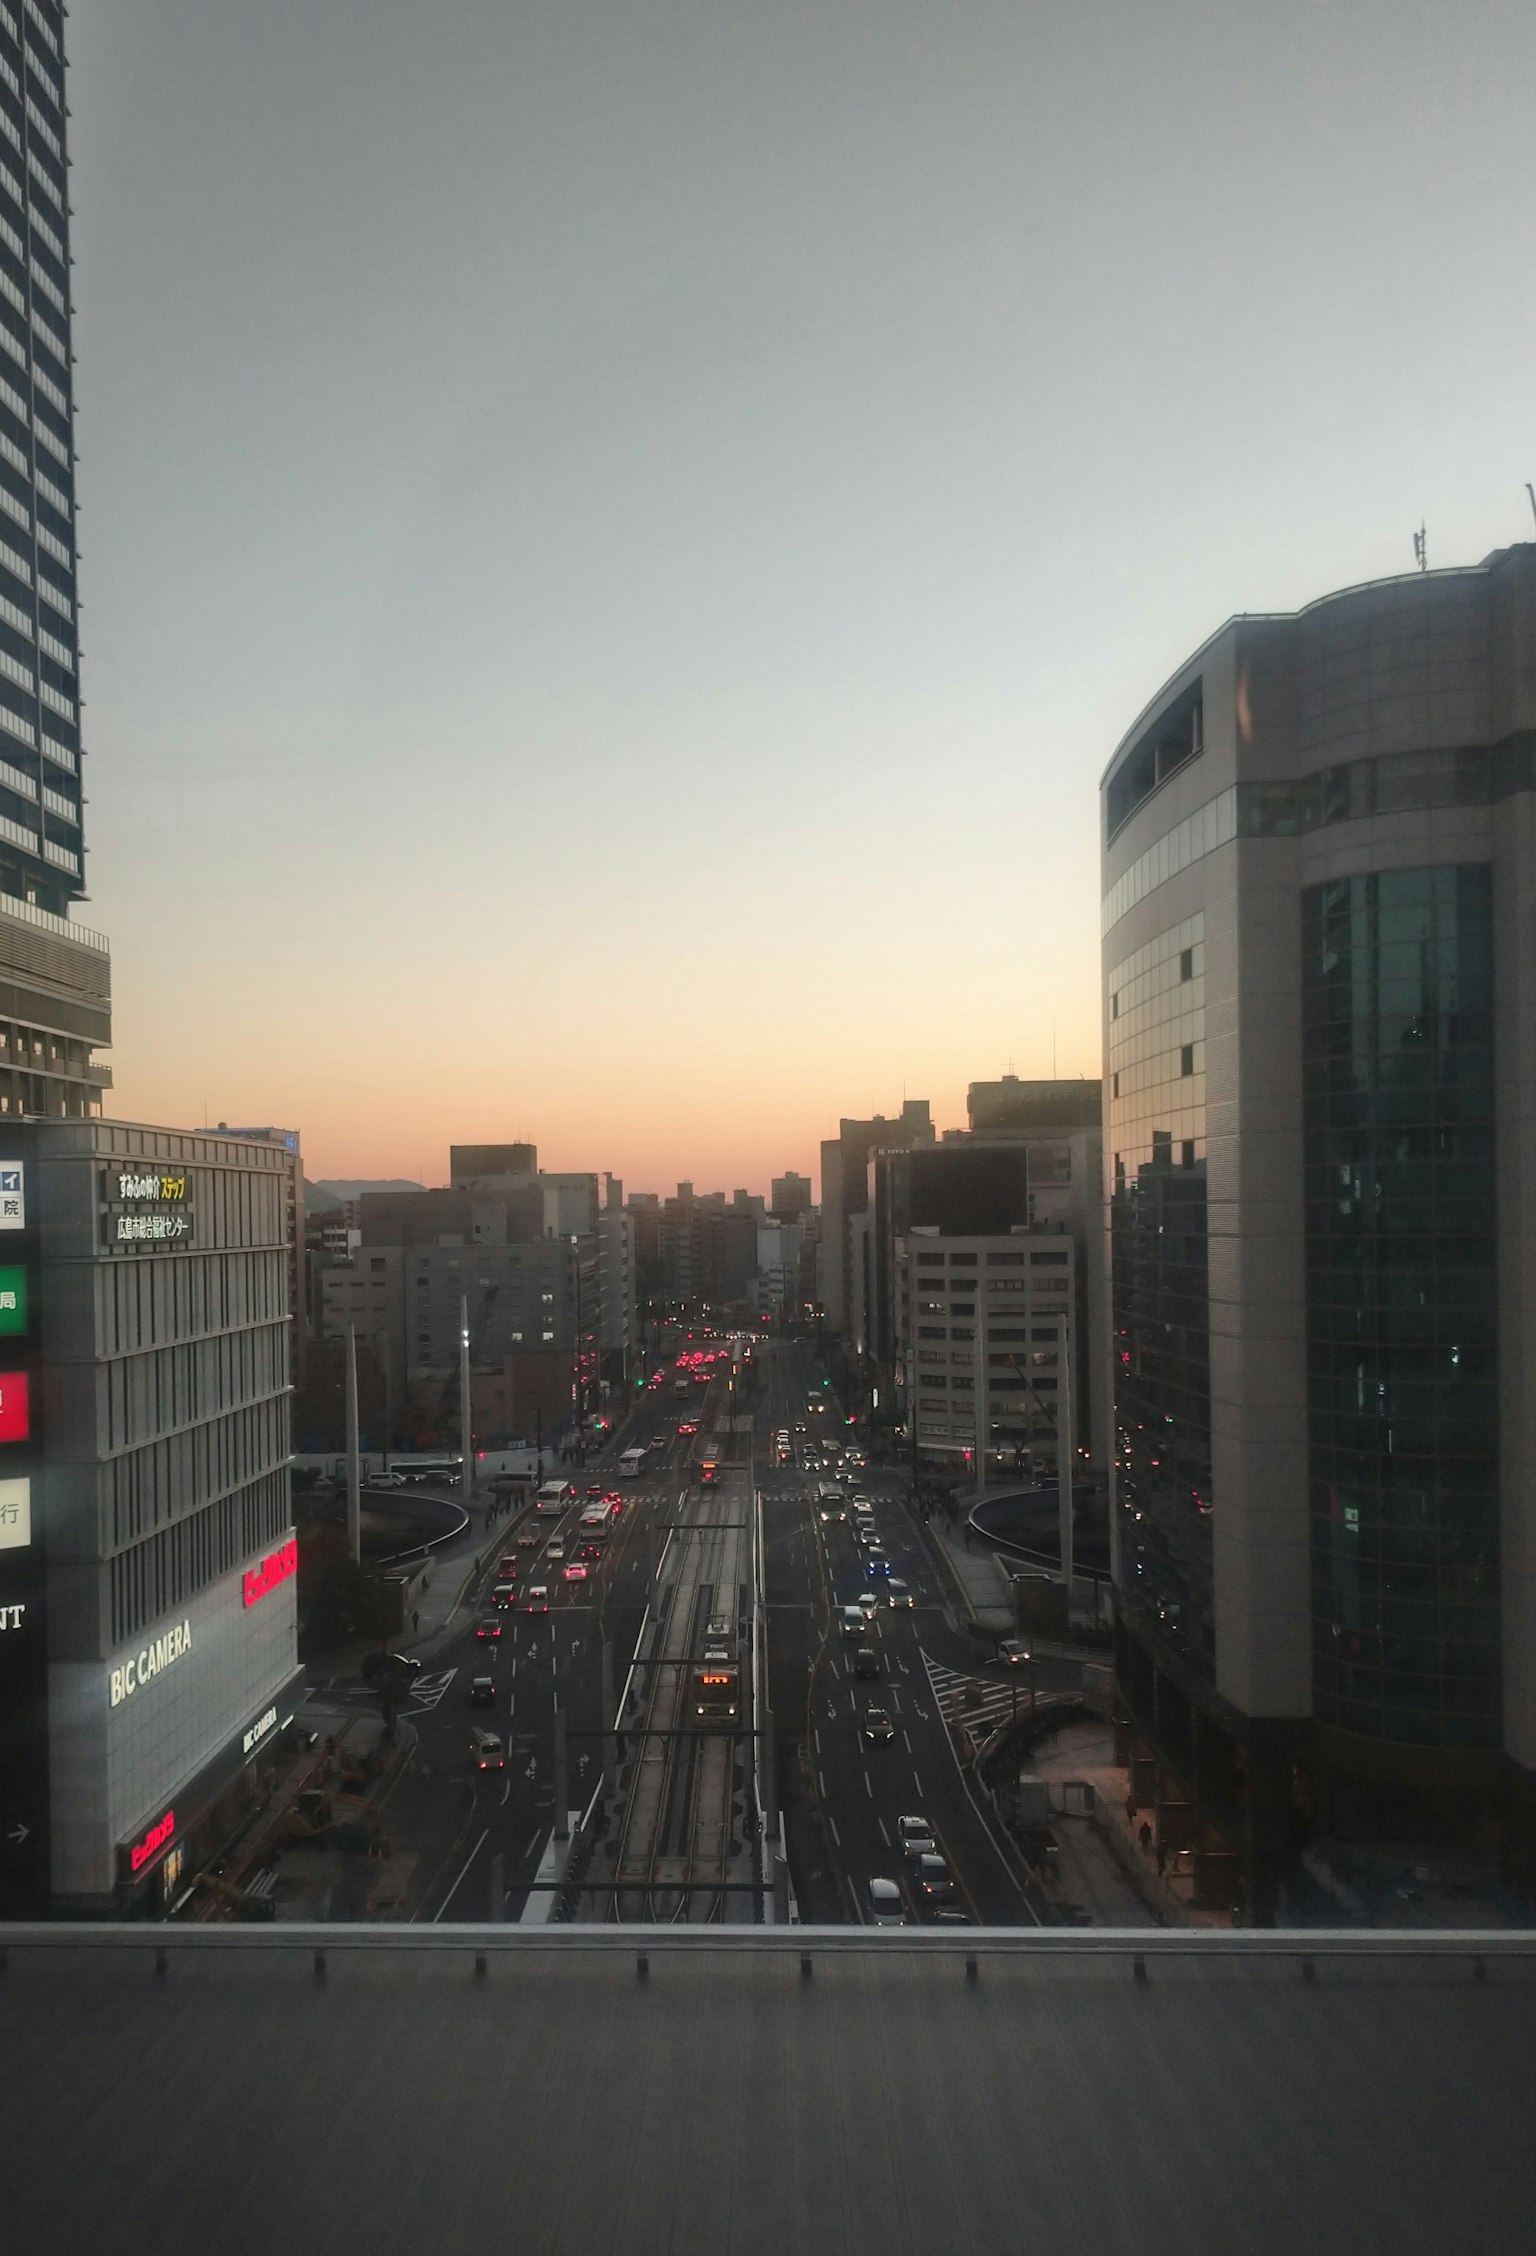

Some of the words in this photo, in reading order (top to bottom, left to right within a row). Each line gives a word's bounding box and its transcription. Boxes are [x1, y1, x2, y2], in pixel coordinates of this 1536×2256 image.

[161, 1177, 185, 1200] ステップ
[4, 1200, 19, 1216] 院
[118, 1216, 188, 1240] 広島市総合福祉センター
[0, 1291, 16, 1310] 局
[0, 1503, 19, 1525] 行
[110, 1659, 137, 1708] BIC
[137, 1619, 192, 1686] CAMERA
